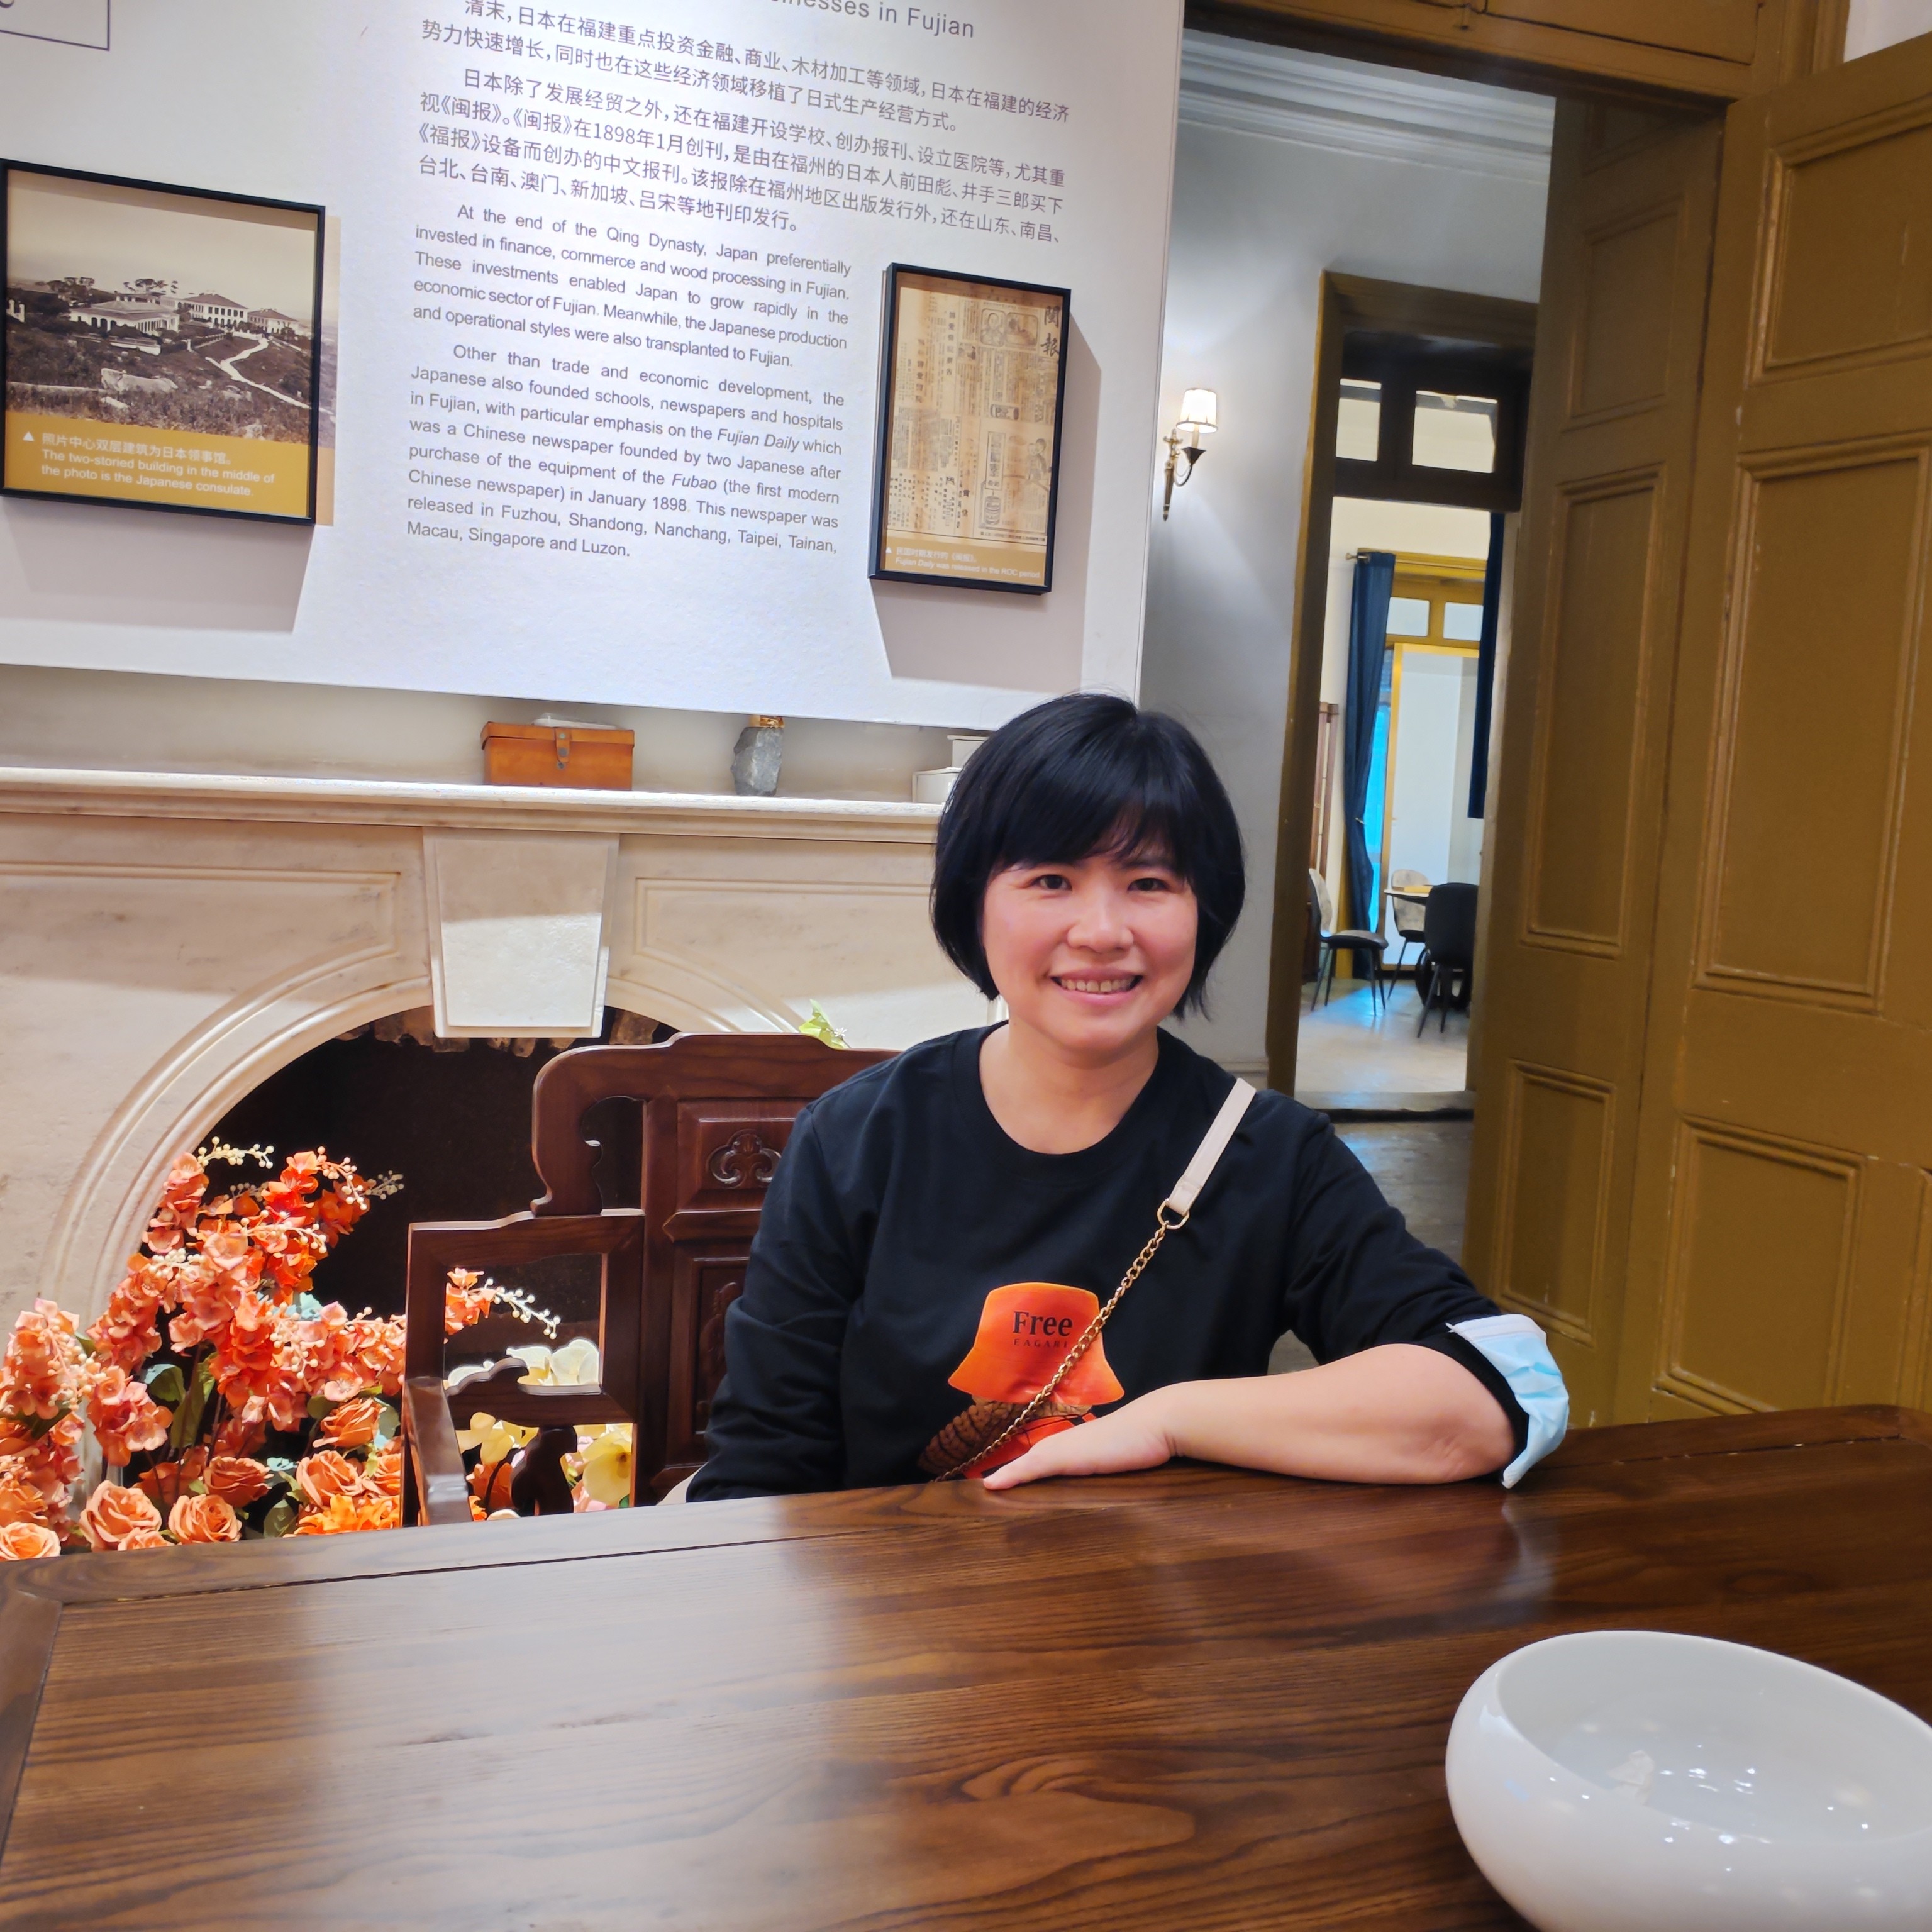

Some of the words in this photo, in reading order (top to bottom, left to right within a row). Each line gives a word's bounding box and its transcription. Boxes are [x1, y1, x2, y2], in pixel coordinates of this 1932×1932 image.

[879, 3, 897, 23] in
[908, 7, 974, 38] Fujian
[416, 224, 477, 247] invested
[482, 234, 495, 249] in
[499, 236, 555, 260] finance,
[560, 249, 635, 269] commerce
[640, 260, 665, 274] and
[670, 265, 708, 280] wood
[712, 271, 786, 294] processing
[790, 278, 801, 293] in
[806, 280, 849, 300] Fujian.
[457, 204, 474, 220] At
[483, 208, 506, 224] the
[515, 216, 543, 230] end
[552, 219, 567, 233] of
[575, 222, 597, 238] the
[606, 226, 639, 247] Qing
[648, 233, 706, 257] Dynasty,
[716, 243, 757, 262] Japan
[766, 253, 852, 278] preferentially
[414, 250, 462, 270] These
[472, 259, 558, 284] investments
[569, 276, 625, 294] enabled
[635, 282, 677, 301] Japan
[687, 291, 701, 304] to
[710, 296, 744, 310] grow
[753, 301, 797, 320] rapidly
[807, 306, 818, 320] in
[828, 309, 848, 325] the
[414, 280, 486, 300] economic
[488, 291, 533, 306] sector
[536, 295, 551, 309] of
[553, 296, 599, 316] Fujian.
[604, 303, 681, 329] Meanwhile,
[684, 315, 706, 330] the
[709, 318, 775, 339] Japanese
[778, 330, 847, 349] production
[413, 306, 441, 320] and
[445, 311, 526, 332] operational
[530, 321, 570, 338] styles
[574, 328, 609, 343] were
[613, 331, 641, 347] also
[645, 336, 729, 358] transplanted
[732, 347, 745, 360] to
[749, 348, 792, 367] Fujian.
[411, 365, 486, 387] Japanese
[492, 376, 523, 392] also
[528, 379, 589, 400] founded
[594, 390, 653, 410] schools,
[660, 399, 745, 419] newspapers
[750, 409, 777, 423] and
[783, 411, 843, 431] hospitals
[453, 344, 497, 362] Other
[508, 352, 540, 368] than
[552, 357, 589, 375] trade
[601, 366, 628, 379] and
[639, 372, 708, 390] economic
[718, 379, 812, 404] development,
[823, 392, 844, 406] the
[409, 420, 440, 433] was
[447, 425, 457, 435] a
[464, 423, 526, 443] Chinese
[532, 435, 614, 455] newspaper
[619, 441, 677, 462] founded
[684, 449, 701, 467] by
[706, 452, 731, 467] two
[736, 455, 804, 475] Japanese
[810, 464, 841, 479] after
[411, 391, 423, 406] in
[430, 392, 479, 414] Fujian,
[485, 401, 515, 416] with
[520, 408, 589, 426] particular
[593, 416, 663, 435] emphasis
[667, 426, 686, 437] on
[690, 425, 712, 440] the
[717, 428, 759, 446] Fujian
[763, 433, 800, 453] Daily
[802, 439, 841, 455] which
[42, 465, 60, 475] the
[64, 468, 97, 479] photo
[101, 471, 110, 480] is
[114, 472, 133, 482] the
[136, 475, 192, 489] Japanese
[43, 449, 64, 460] The
[69, 453, 134, 468] two-storied
[138, 460, 183, 475] building
[187, 466, 197, 474] in
[201, 467, 218, 477] the
[223, 470, 260, 481] middle
[264, 474, 274, 482] of
[409, 447, 479, 464] purchase
[487, 453, 502, 466] of
[508, 455, 531, 470] the
[538, 461, 616, 480] equipment
[622, 468, 637, 482] of
[642, 470, 665, 485] the
[671, 473, 717, 490] Fubao
[723, 479, 750, 496] (the
[756, 482, 781, 497] first
[787, 488, 839, 504] modern
[408, 469, 471, 489] Chinese
[477, 479, 565, 502] newspaper)
[570, 487, 582, 501] in
[588, 489, 647, 511] January
[652, 496, 689, 512] 1898.
[696, 500, 726, 516] This
[731, 507, 808, 526] newspaper
[811, 515, 838, 528] was
[408, 496, 473, 514] released
[481, 502, 494, 517] in
[501, 504, 560, 526] Fuzhou,
[569, 512, 647, 536] Shandong,
[655, 521, 730, 545] Nanchang,
[738, 529, 781, 548] Taipei,
[787, 534, 836, 554] Tainan,
[408, 521, 463, 541] Macau,
[468, 527, 545, 548] Singapore
[550, 538, 577, 551] and
[582, 539, 630, 557] Luzon.
[918, 559, 935, 568] Daily
[1013, 1311, 1072, 1336] Free
